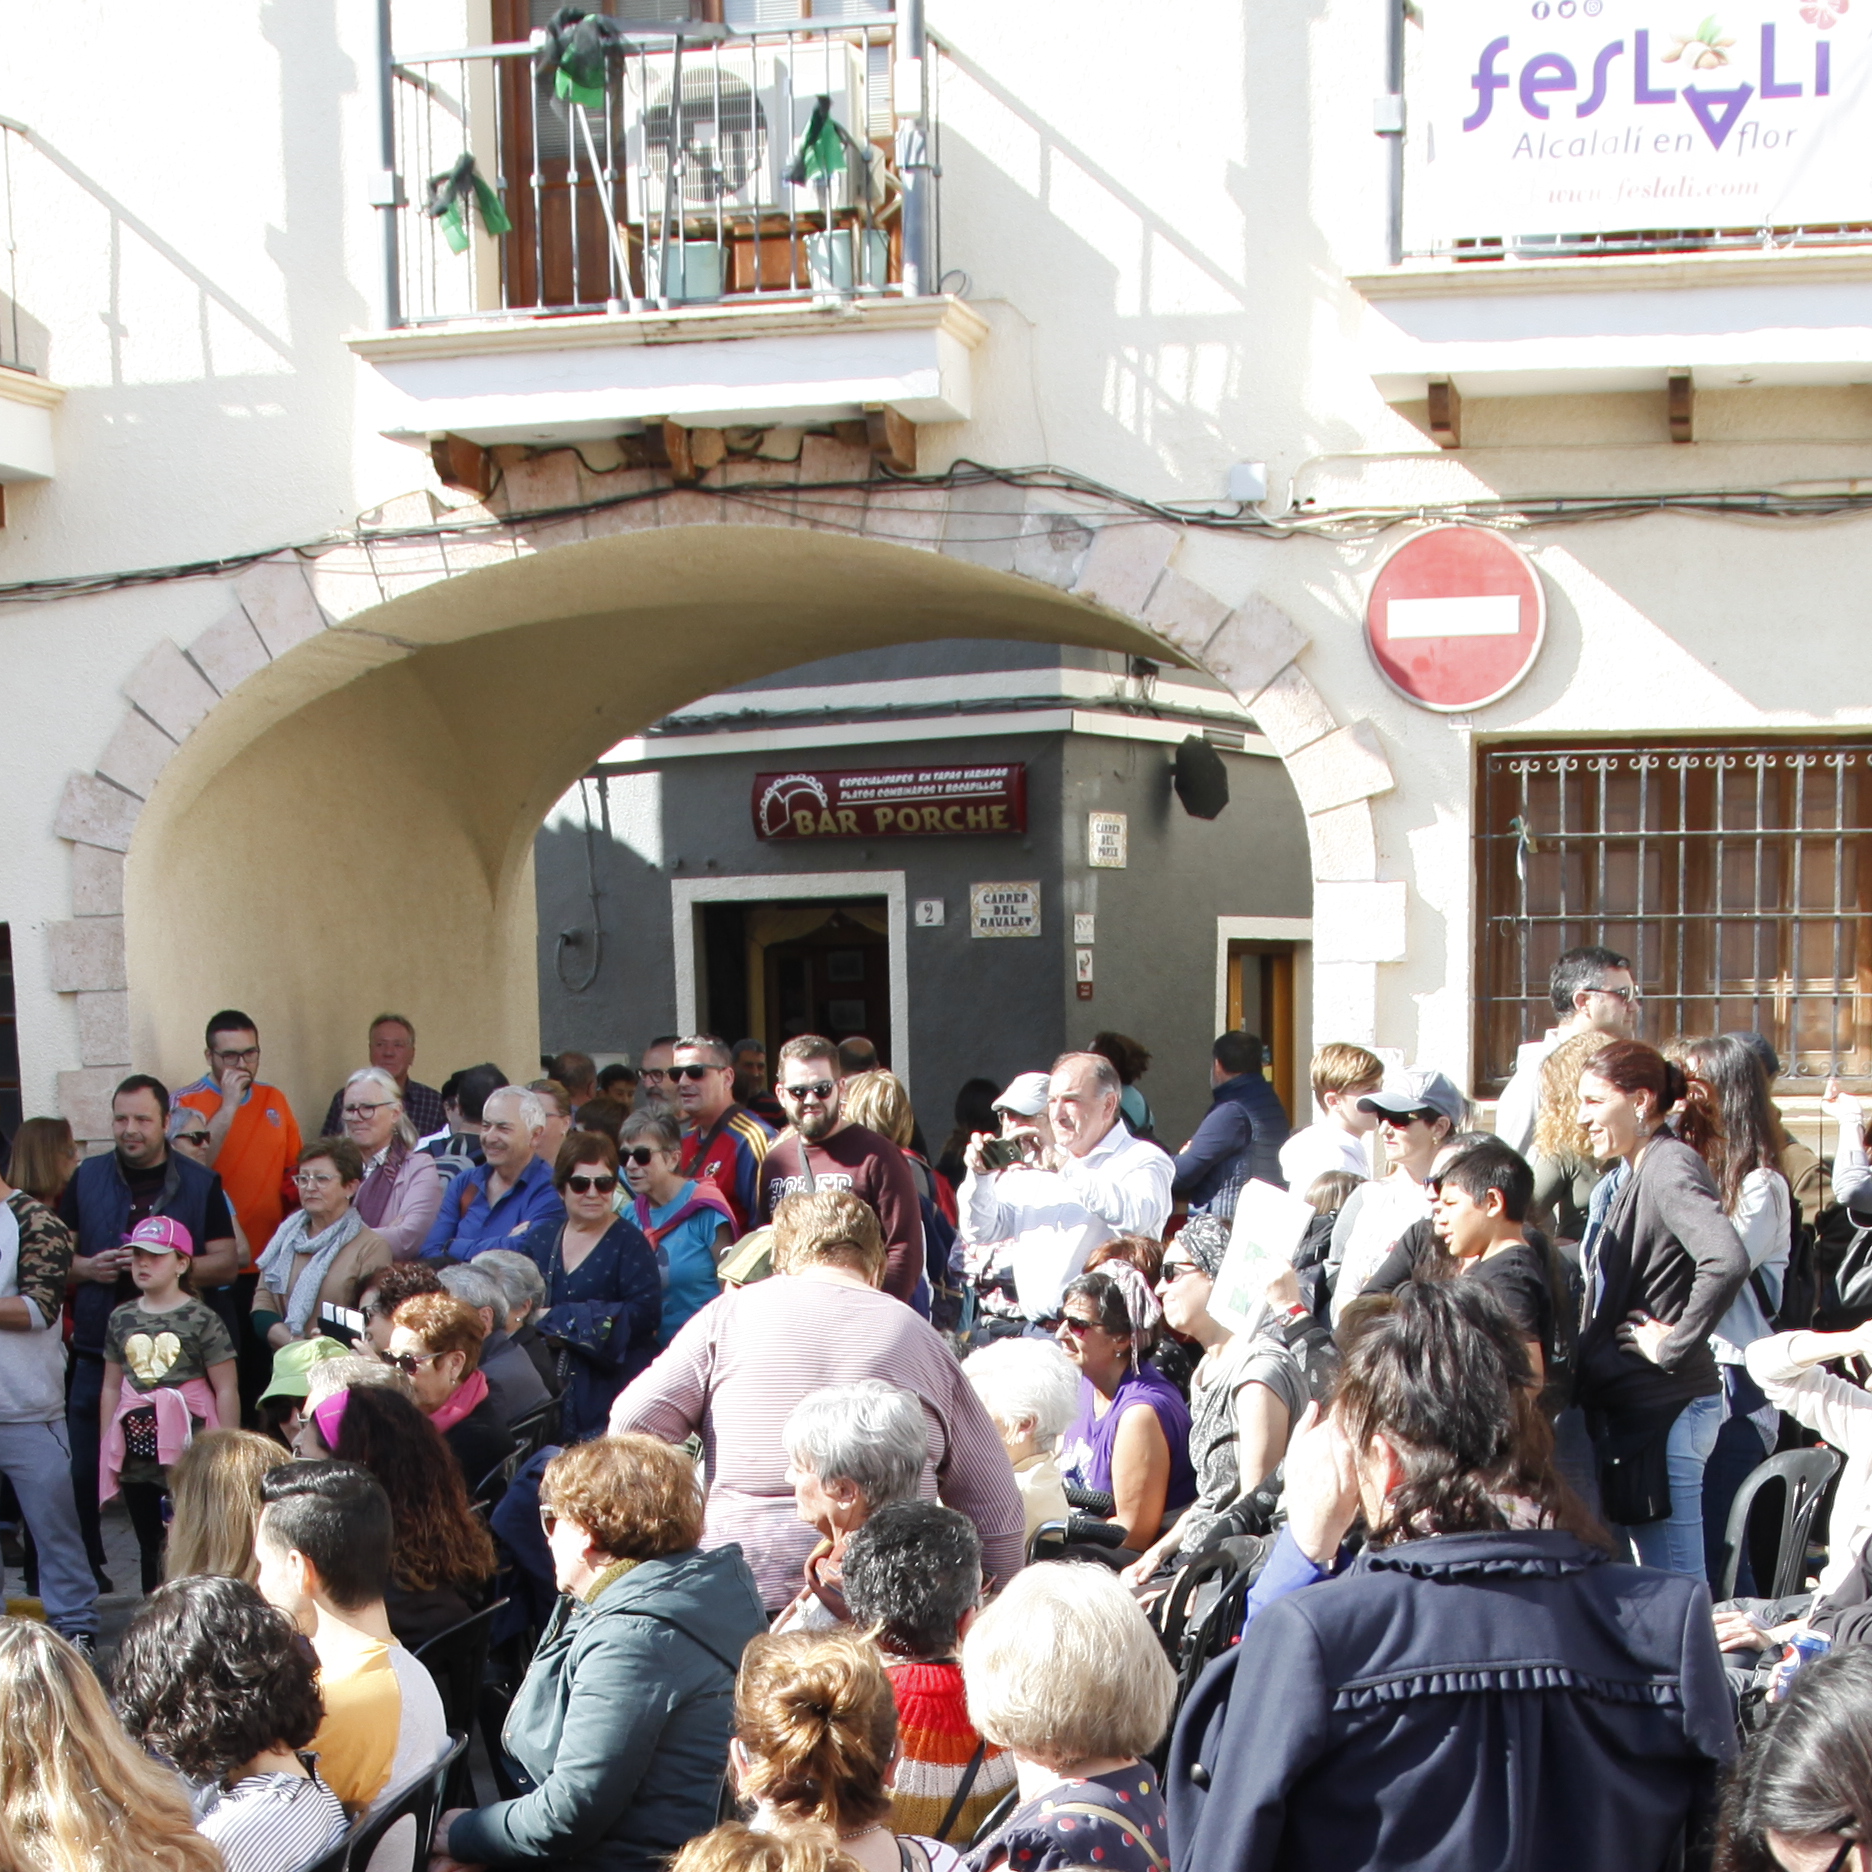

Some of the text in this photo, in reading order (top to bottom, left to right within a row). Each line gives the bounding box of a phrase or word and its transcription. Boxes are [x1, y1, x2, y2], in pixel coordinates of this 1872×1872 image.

[1654, 131, 1693, 154] en
[1737, 121, 1799, 157] flor
[933, 770, 962, 782] TAPAS
[840, 787, 876, 800] PLATOS
[938, 784, 944, 794] Y
[793, 804, 1009, 835] BAR PORCHE
[983, 892, 1028, 904] CARRER
[924, 902, 934, 923] 2
[993, 904, 1018, 916] DEL
[980, 916, 1032, 928] RAVALET
